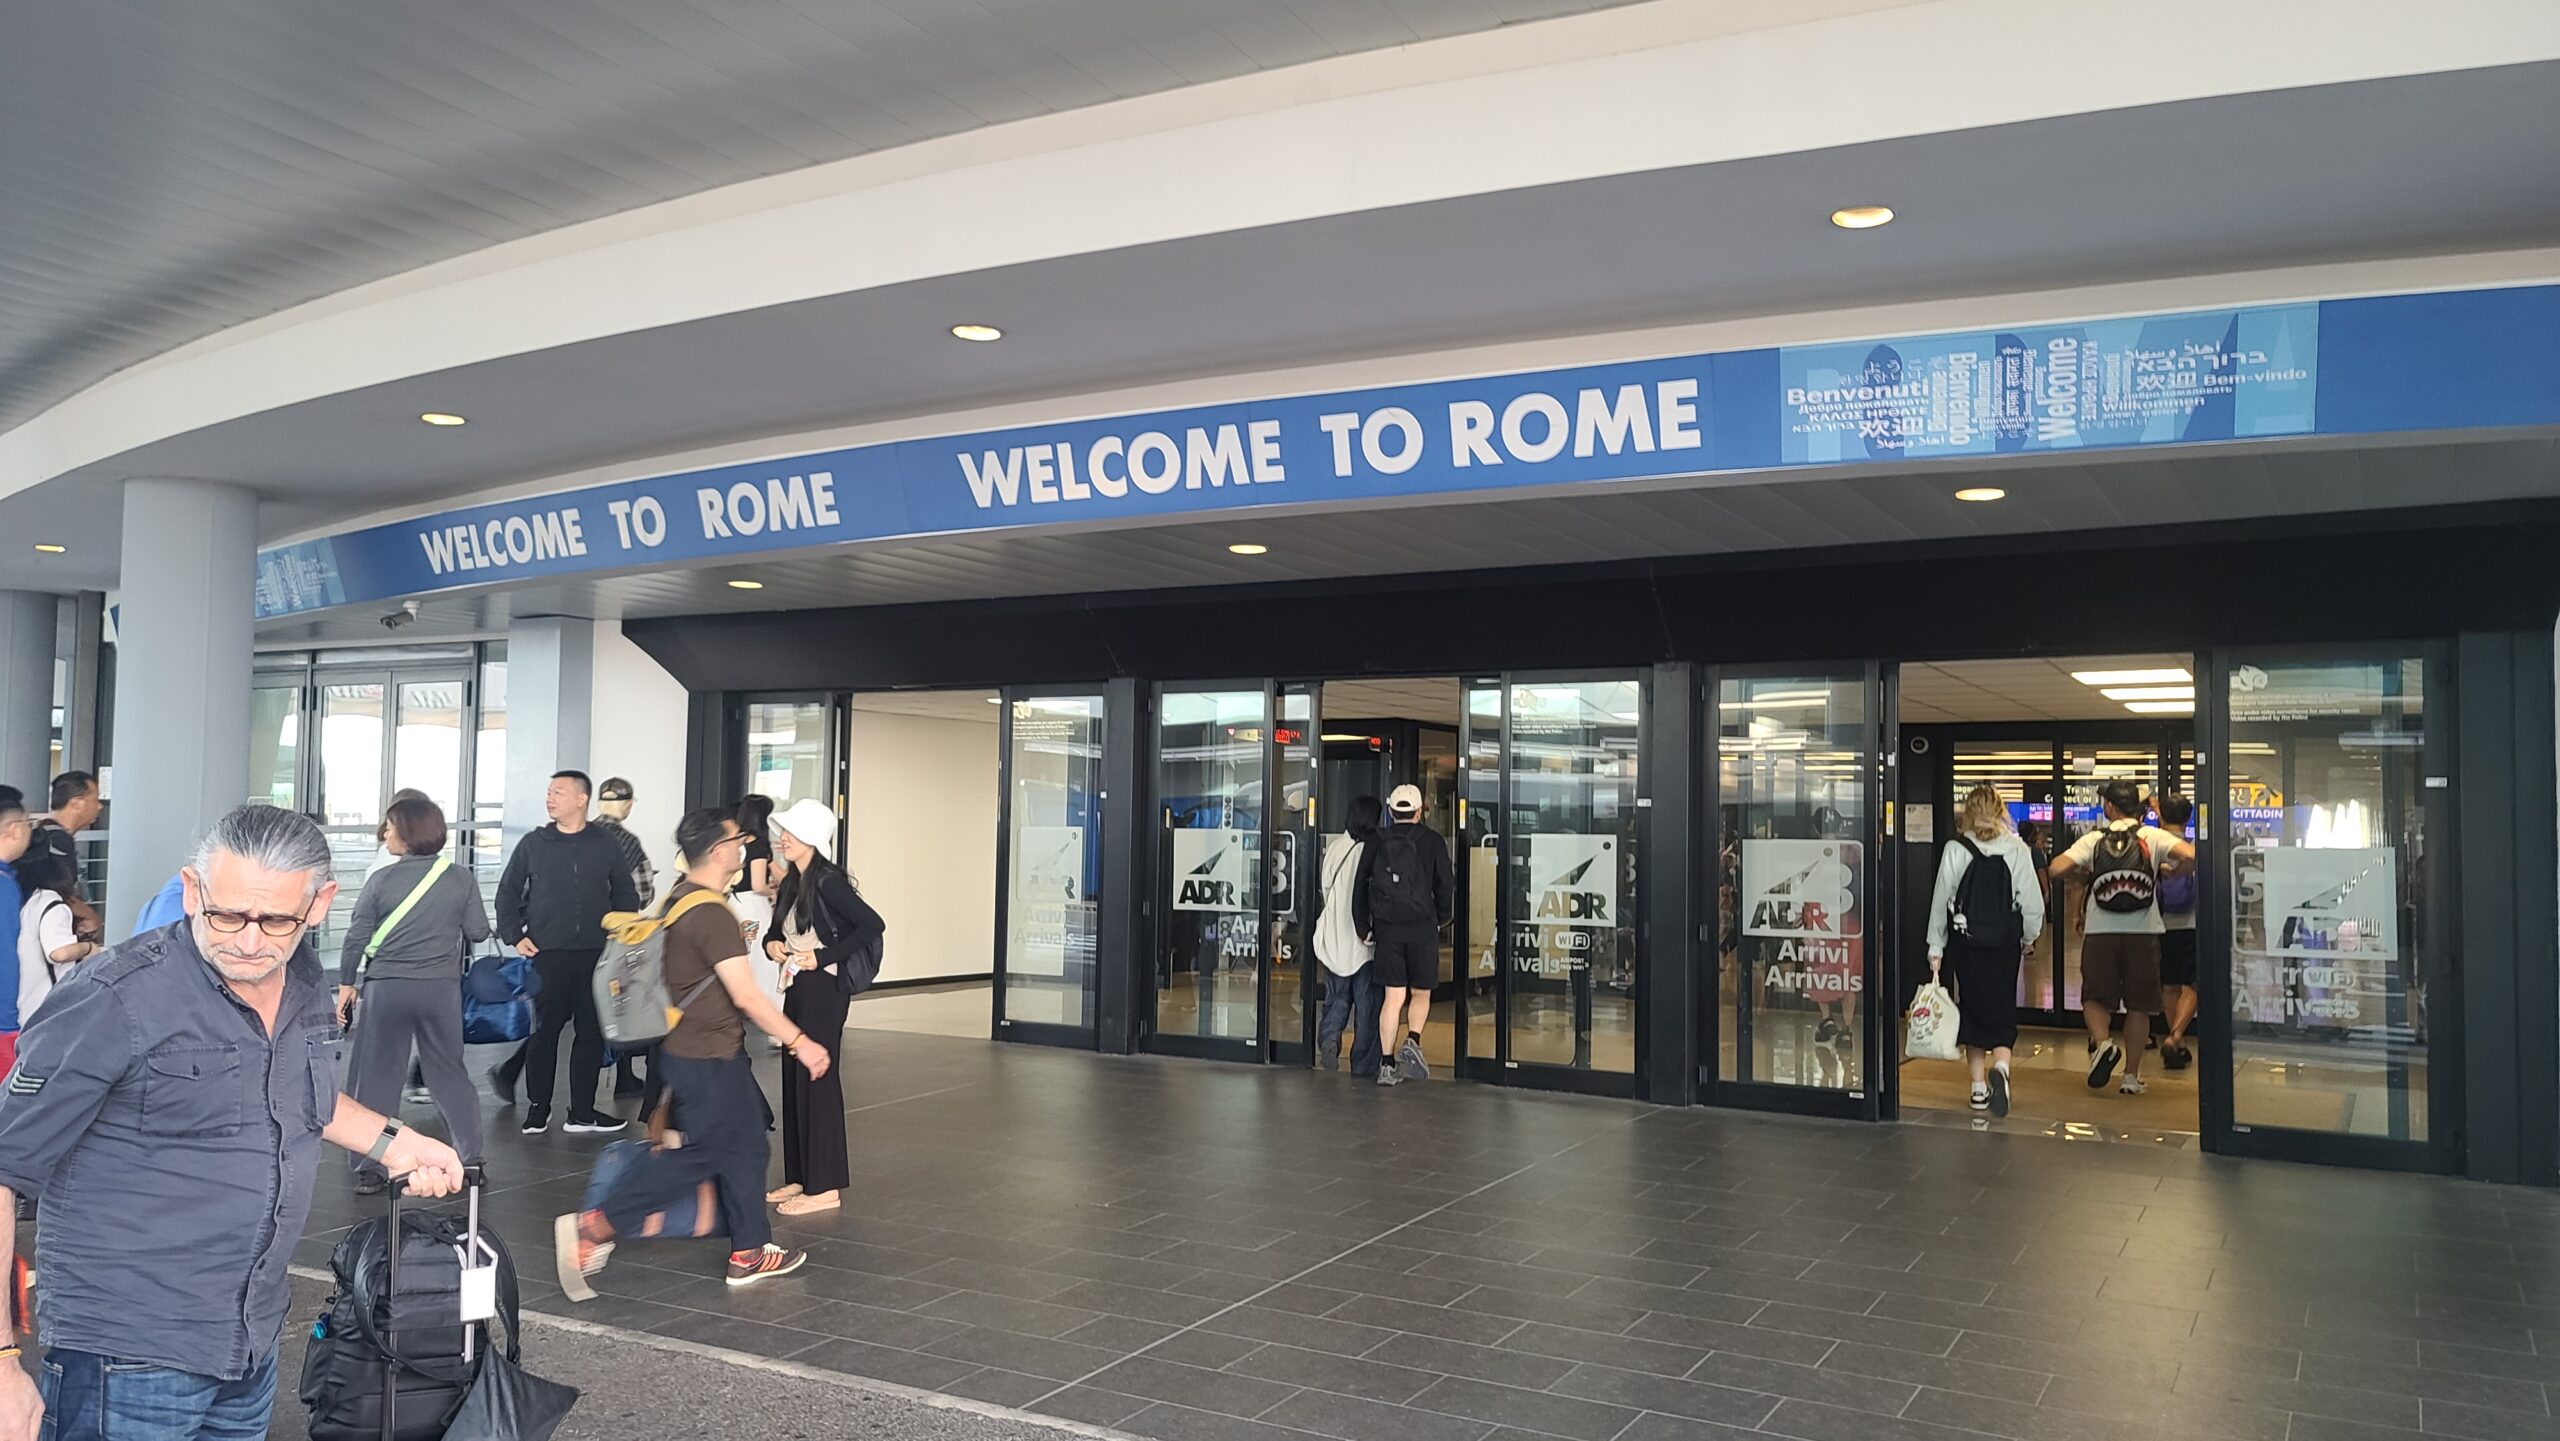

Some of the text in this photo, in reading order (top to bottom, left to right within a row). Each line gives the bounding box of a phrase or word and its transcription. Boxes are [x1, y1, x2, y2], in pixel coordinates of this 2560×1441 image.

[2136, 350, 2268, 373] ברוך הבא
[2038, 336, 2078, 442] Welcome
[2135, 370, 2198, 391] 欢迎
[2203, 367, 2308, 387] Bem-vindo
[1786, 377, 1930, 406] Benvenuti
[1949, 352, 1979, 445] Bienvenido
[2101, 395, 2206, 412] Willkommen
[1857, 416, 1925, 439] 欢迎
[957, 378, 1703, 508] WELCOME TO ROME
[419, 471, 841, 575] WELCOME TO ROME
[1178, 880, 1236, 906] ADR
[1536, 889, 1610, 920] ADR
[1231, 915, 1283, 936] Arri
[1749, 899, 1834, 932] ADR
[1221, 937, 1292, 960] Arrils
[1777, 938, 1849, 964] Arrivi
[1764, 964, 1863, 993] Arrivals
